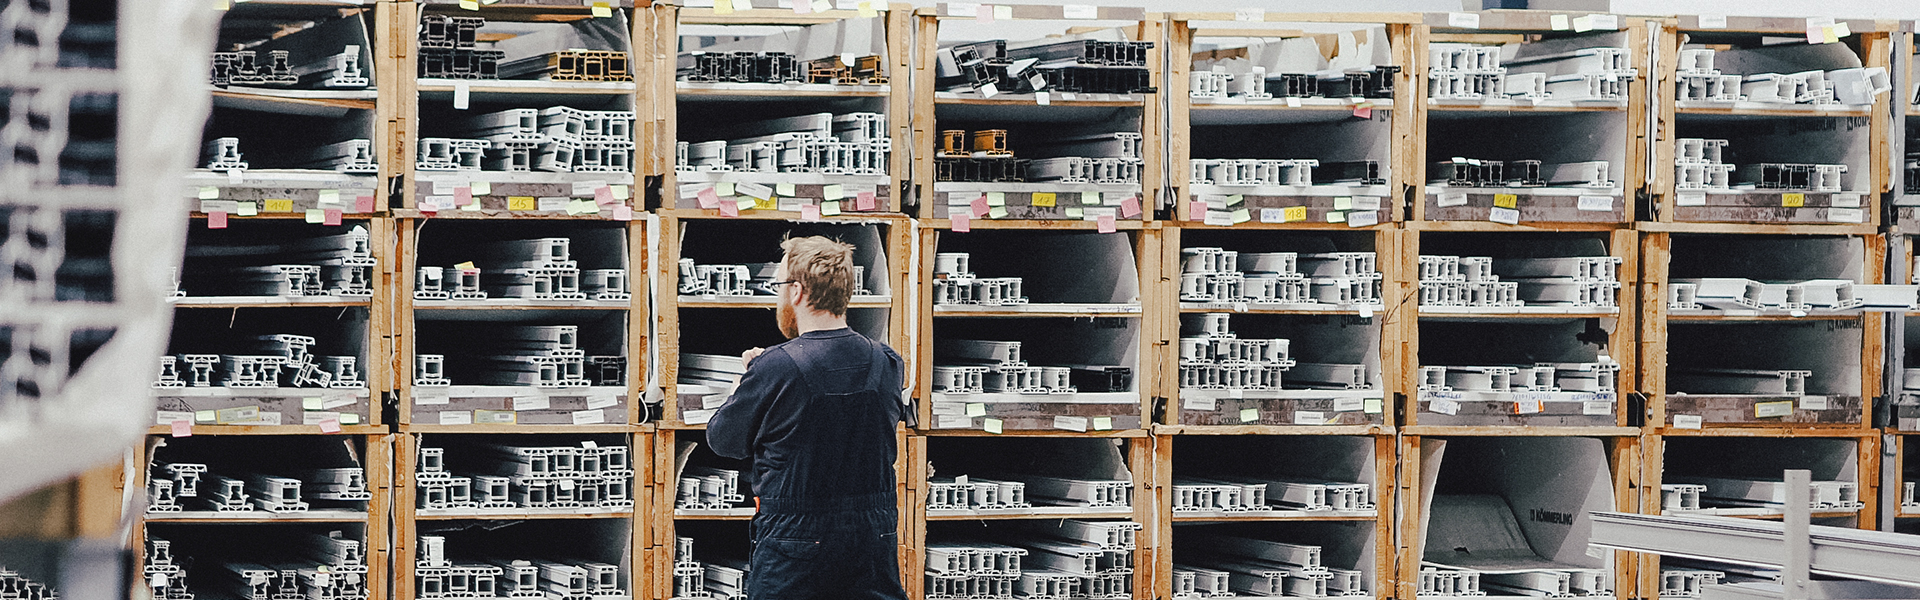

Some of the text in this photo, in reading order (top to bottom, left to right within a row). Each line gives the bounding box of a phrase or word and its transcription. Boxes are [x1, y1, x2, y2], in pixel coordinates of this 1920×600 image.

[270, 200, 286, 210] 14
[512, 199, 527, 209] 15
[1786, 195, 1800, 205] 20
[1288, 208, 1302, 220] 18
